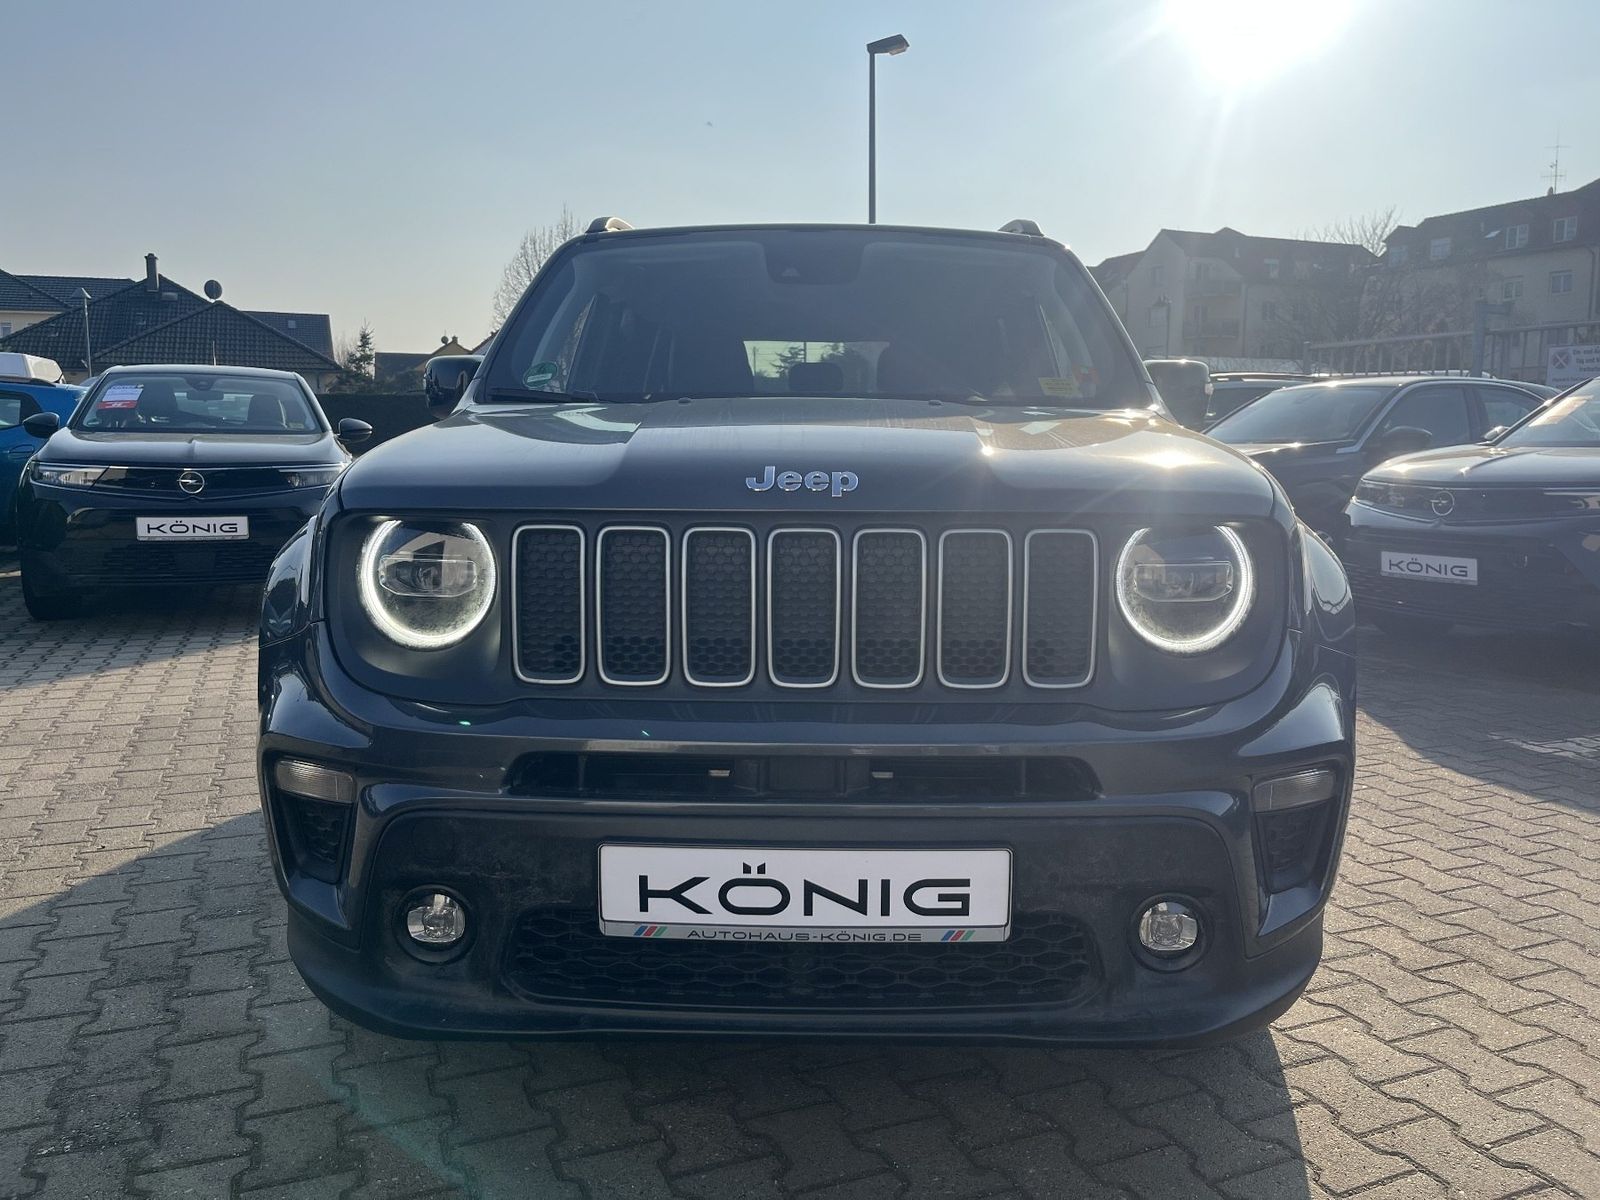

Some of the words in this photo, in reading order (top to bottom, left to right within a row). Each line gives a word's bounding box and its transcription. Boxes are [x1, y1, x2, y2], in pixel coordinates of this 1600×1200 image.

[745, 465, 859, 498] Jeep
[147, 520, 238, 534] KÖNIG
[1388, 557, 1468, 577] KÖNIG
[638, 861, 972, 917] KÖNIG
[686, 929, 923, 943] AUTOHAUS-KÖNIG.DE
